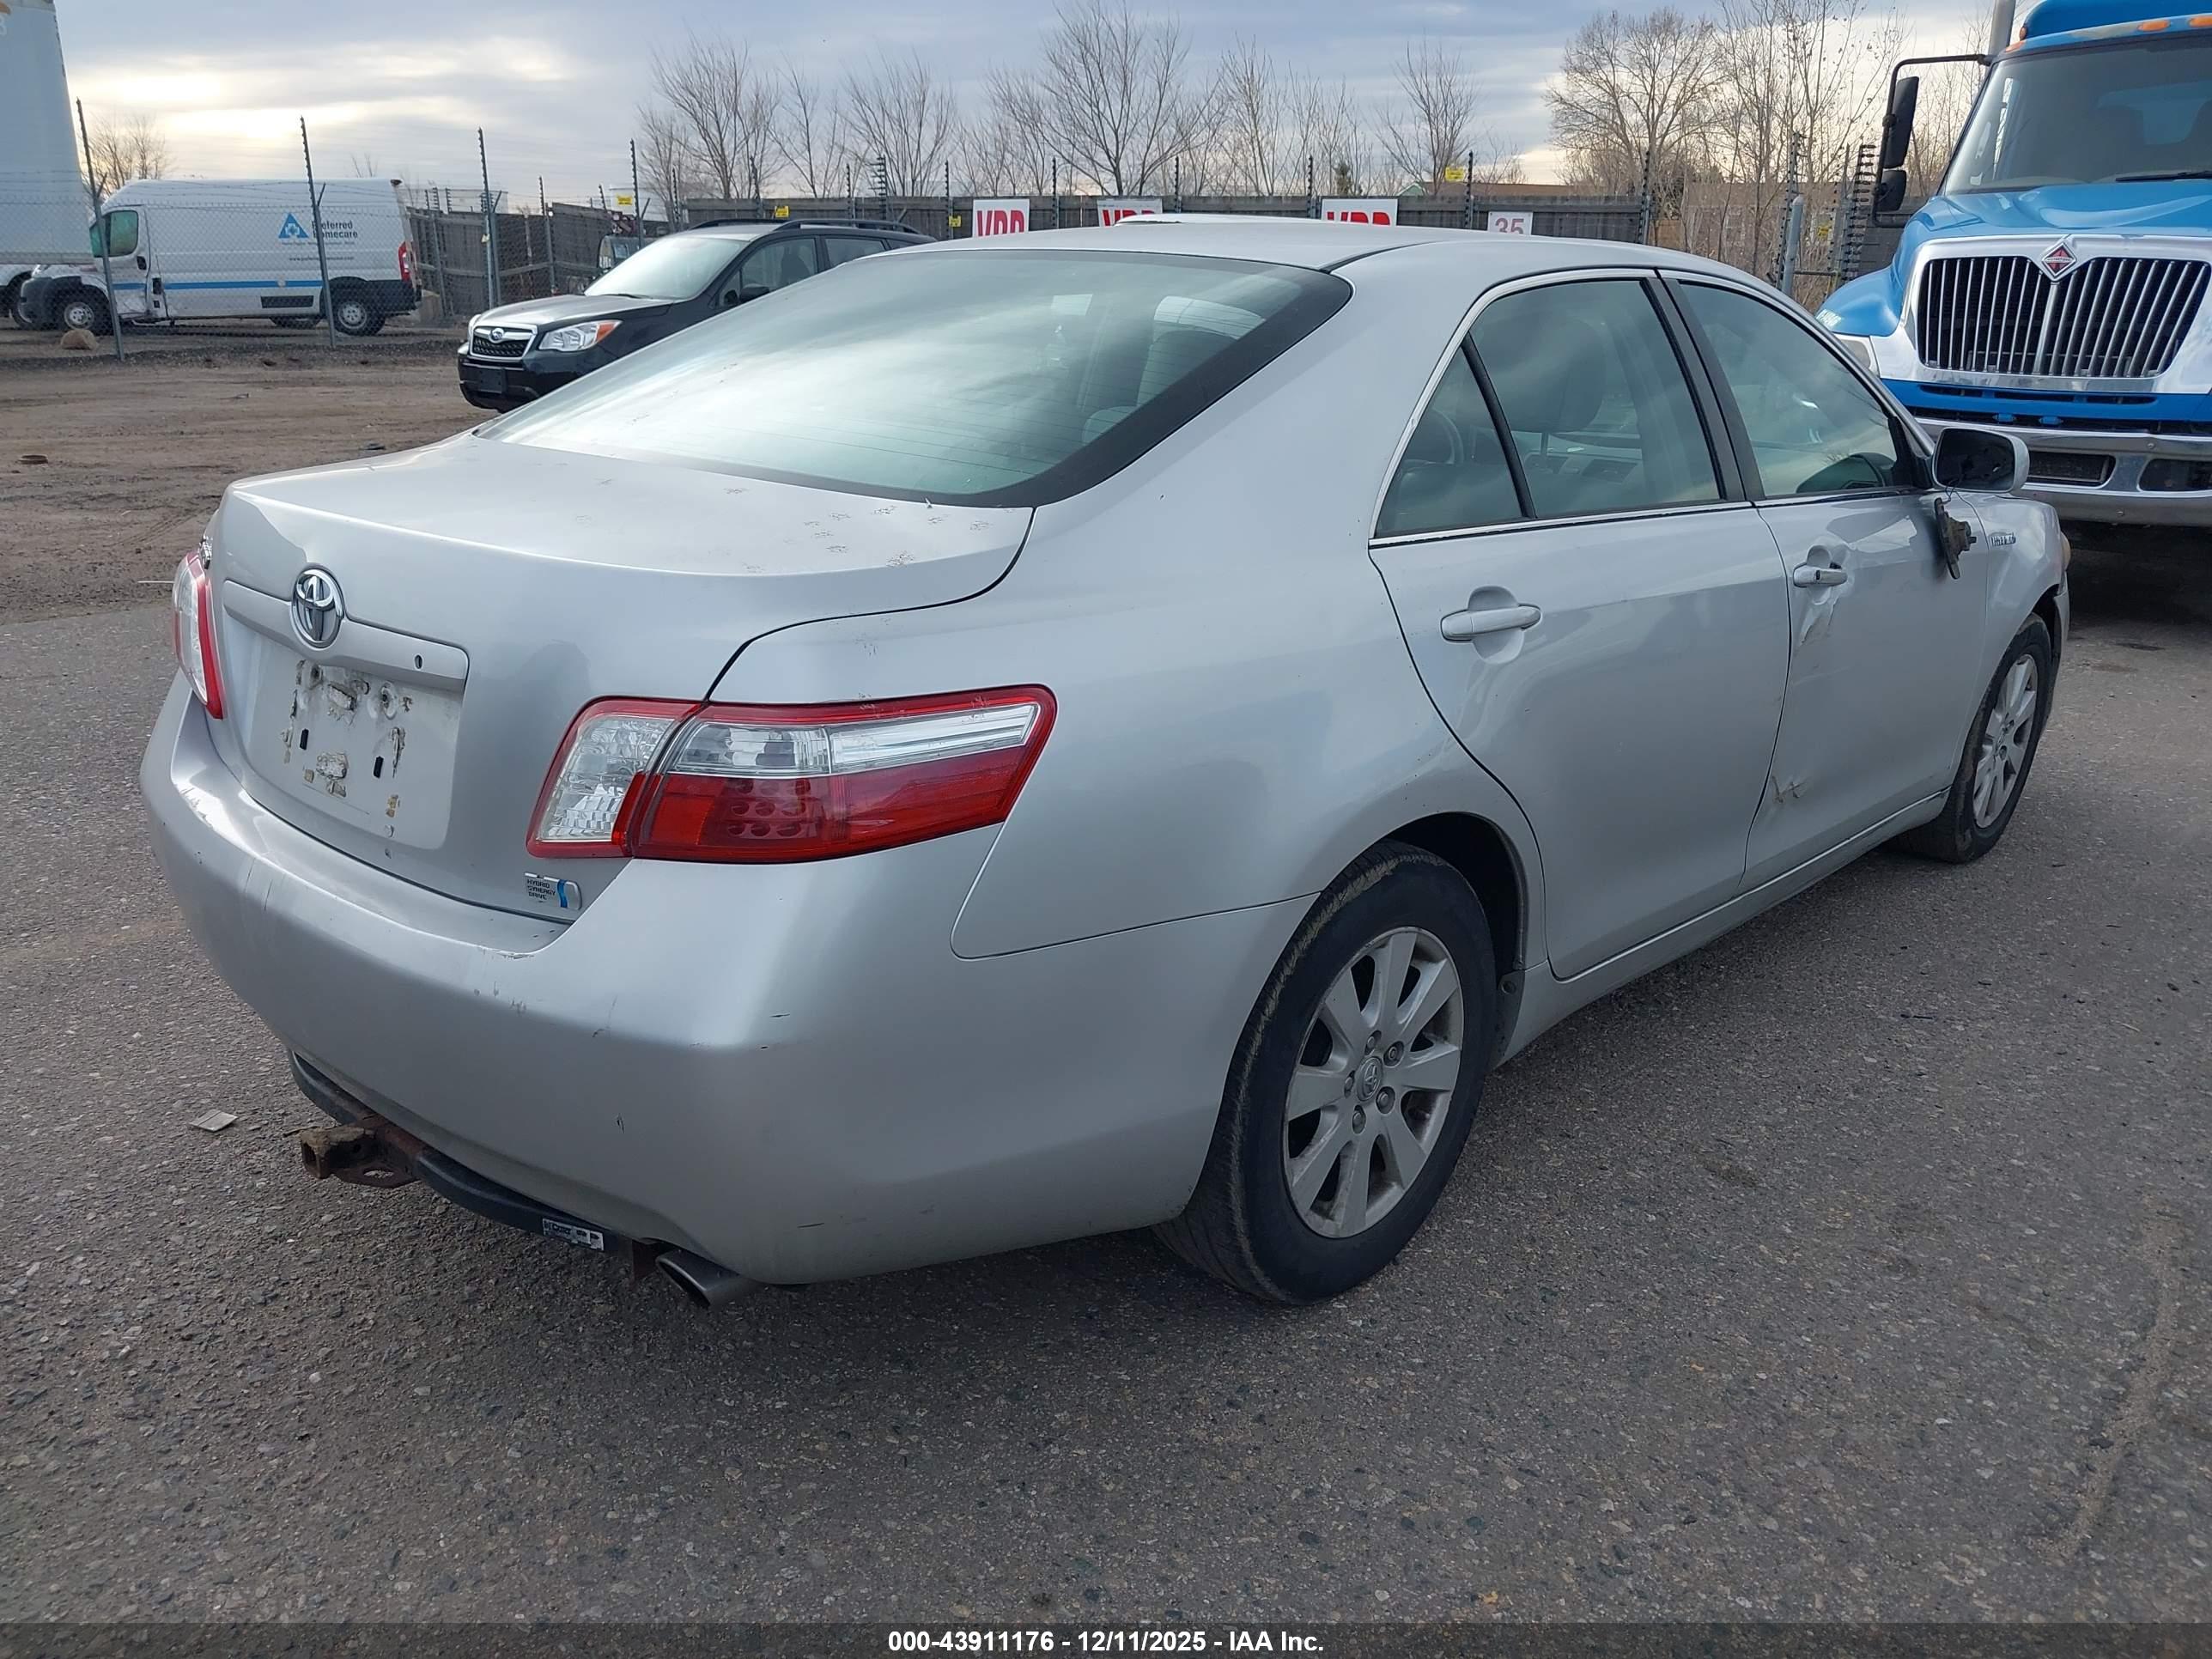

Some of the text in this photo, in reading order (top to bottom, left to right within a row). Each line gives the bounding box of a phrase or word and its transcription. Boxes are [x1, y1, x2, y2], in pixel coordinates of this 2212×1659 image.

[527, 879, 550, 889] HYBRID
[527, 885, 556, 896] SYNERGY
[528, 891, 547, 901] DRIVE
